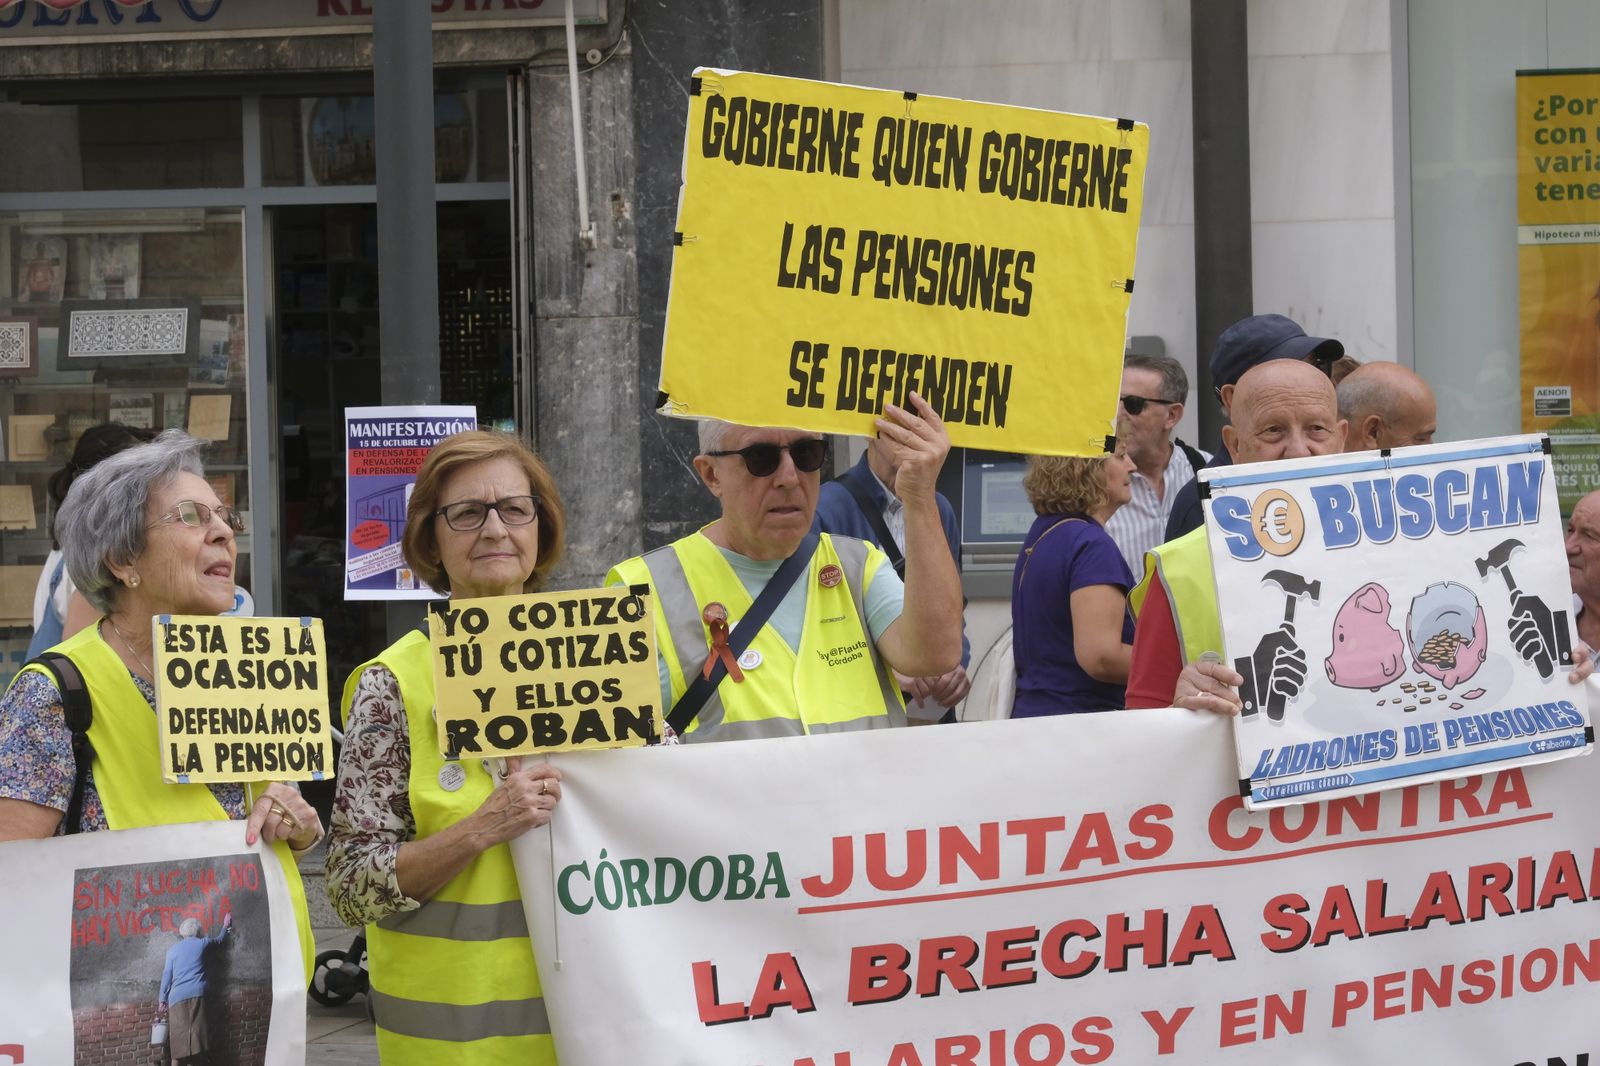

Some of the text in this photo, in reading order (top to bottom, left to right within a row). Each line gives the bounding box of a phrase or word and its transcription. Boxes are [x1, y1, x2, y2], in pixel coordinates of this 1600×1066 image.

[702, 93, 1133, 214] GOBIERNE QUIEN GOBIERNE
[1534, 127, 1586, 145] con
[1534, 230, 1580, 240] Hipoteca
[777, 221, 1036, 318] LAS PENSIONES
[787, 340, 1013, 429] SE DEFIENDEN
[1537, 389, 1568, 397] AENOR
[350, 419, 473, 438] MANIFESTACIÓN
[384, 439, 418, 447] OCTUBRE
[356, 466, 417, 475] EN PENSIONES
[366, 449, 405, 457] DEFENSA
[1553, 463, 1583, 474] RQUE
[1554, 474, 1579, 487] RES
[1309, 460, 1546, 550] BUSCAN
[821, 570, 839, 580] STOP
[441, 597, 642, 637] YO COTIZO
[164, 624, 317, 656] ESTA ES LA
[440, 630, 650, 678] TÚ COTIZAS
[166, 657, 319, 690] OCASIÓN
[473, 678, 623, 713] Y ELLOS
[169, 702, 321, 736] DEFENDÁMOS
[446, 704, 655, 754] ROBAN
[171, 735, 324, 773] LA PENSIÓN
[1250, 700, 1586, 780] LADRONES DE PENSIONES
[557, 767, 1532, 915] CÓRDOBA JUNTAS CONTRA
[135, 868, 221, 900] LUCHA
[229, 861, 260, 892] NO
[72, 912, 111, 947] HAY
[692, 952, 817, 1027] LA
[847, 904, 1236, 1006] BRECHA
[754, 1016, 1116, 1066] ARIOS
[1141, 1005, 1195, 1056] Y
[1219, 989, 1307, 1048] EN
